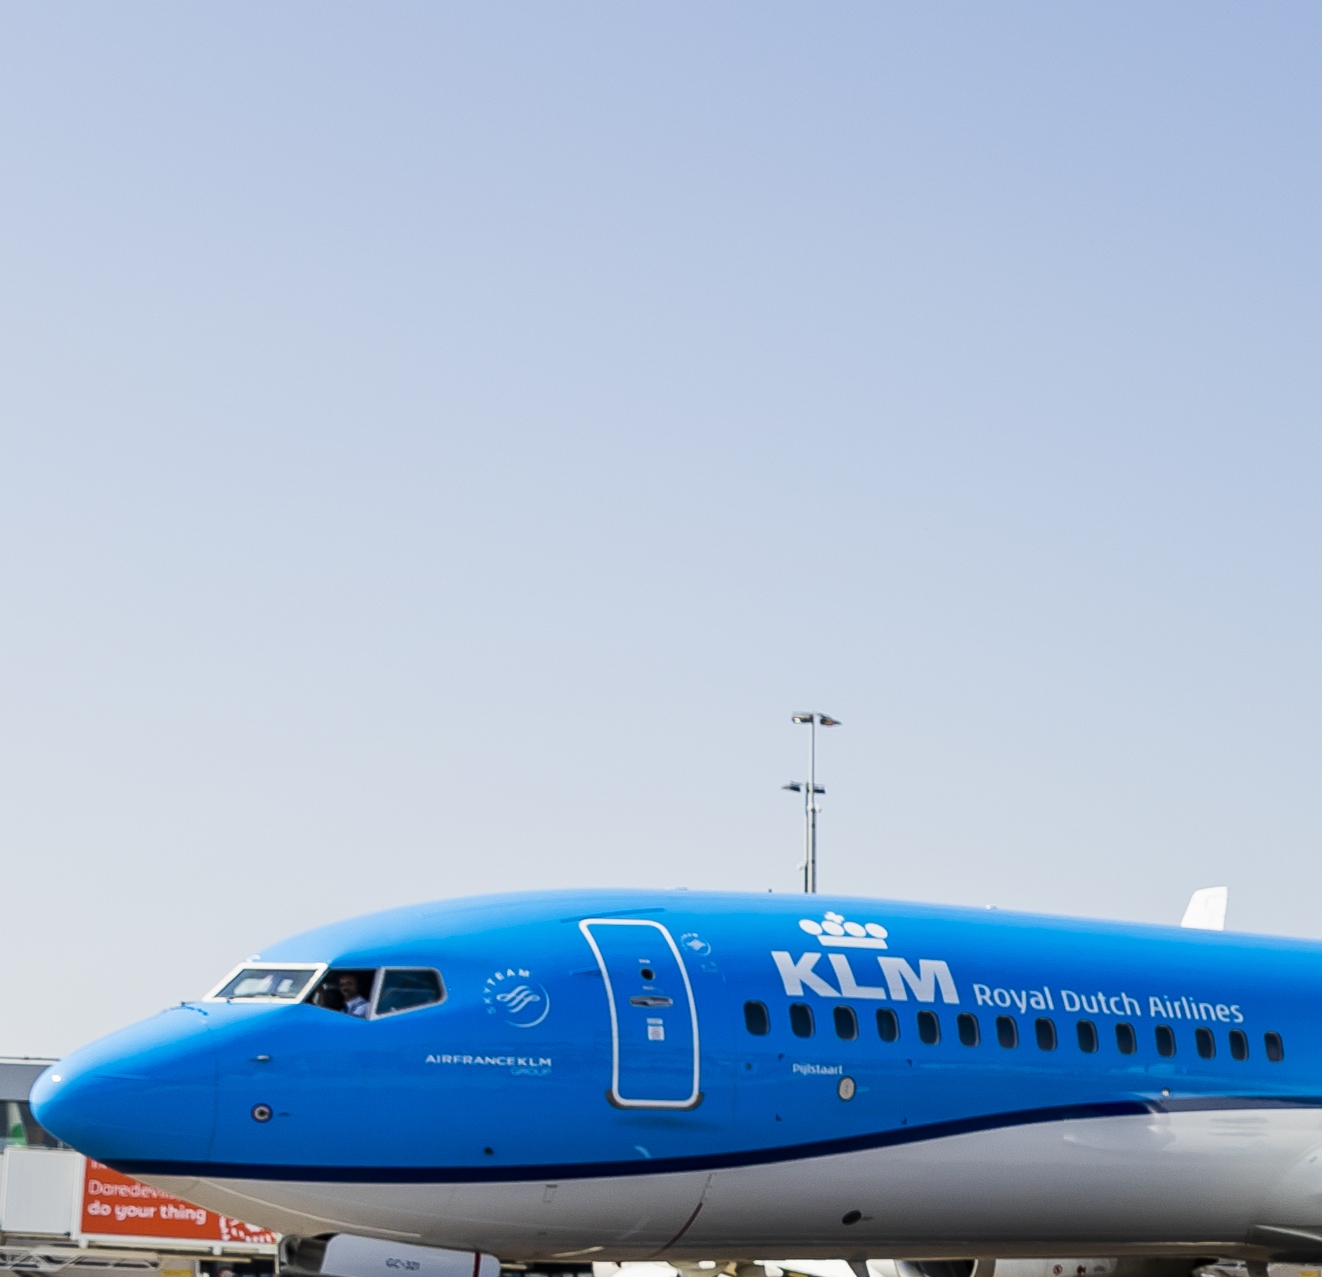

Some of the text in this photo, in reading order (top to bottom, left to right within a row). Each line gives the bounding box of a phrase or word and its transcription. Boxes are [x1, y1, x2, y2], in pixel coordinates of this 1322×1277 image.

[771, 950, 960, 1004] KLM
[973, 983, 1244, 1023] Royal Dutch Airlines
[87, 1200, 207, 1225] do your thing
